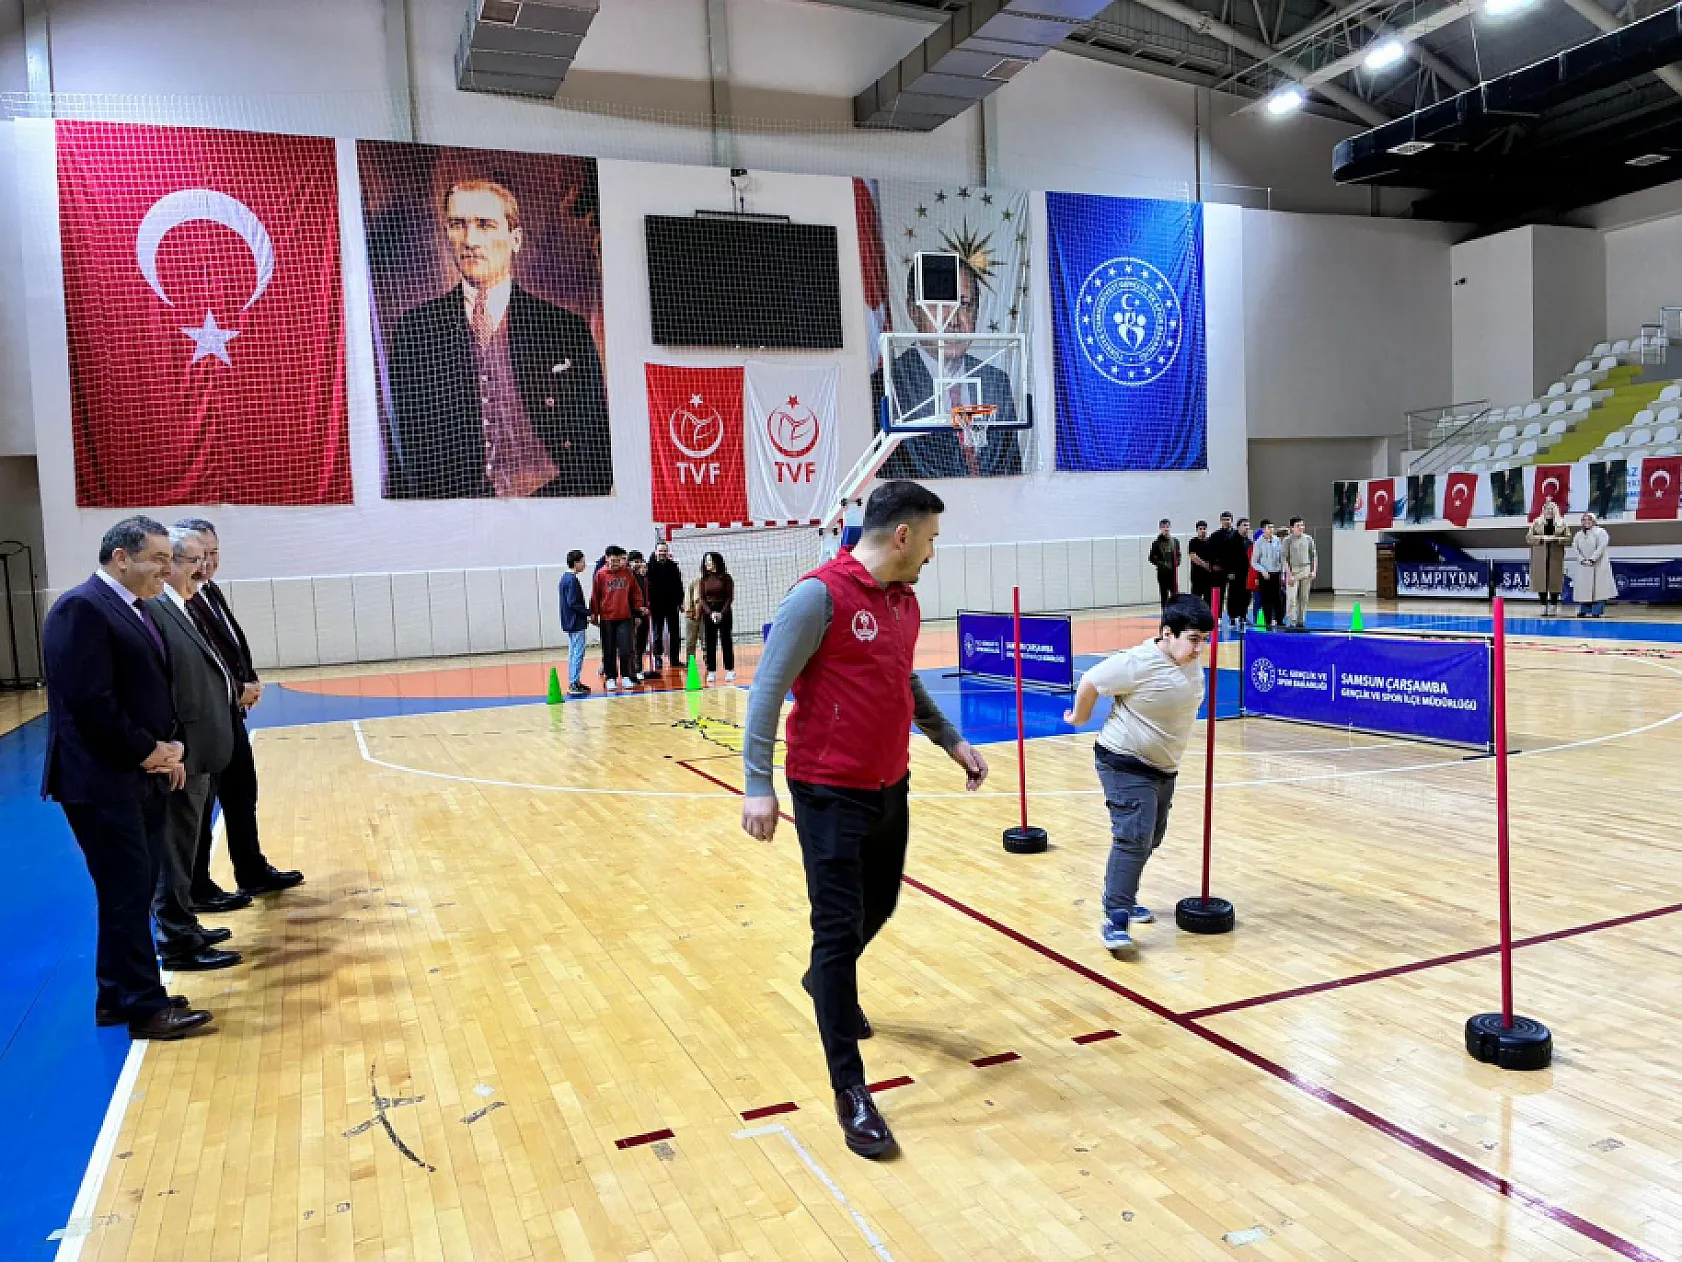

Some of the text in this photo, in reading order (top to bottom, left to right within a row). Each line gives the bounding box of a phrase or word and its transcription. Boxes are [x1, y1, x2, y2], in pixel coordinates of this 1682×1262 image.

[676, 462, 721, 485] TVF
[774, 461, 816, 483] TVF
[1341, 673, 1448, 694] SAMSUN ÇARŞAMBA
